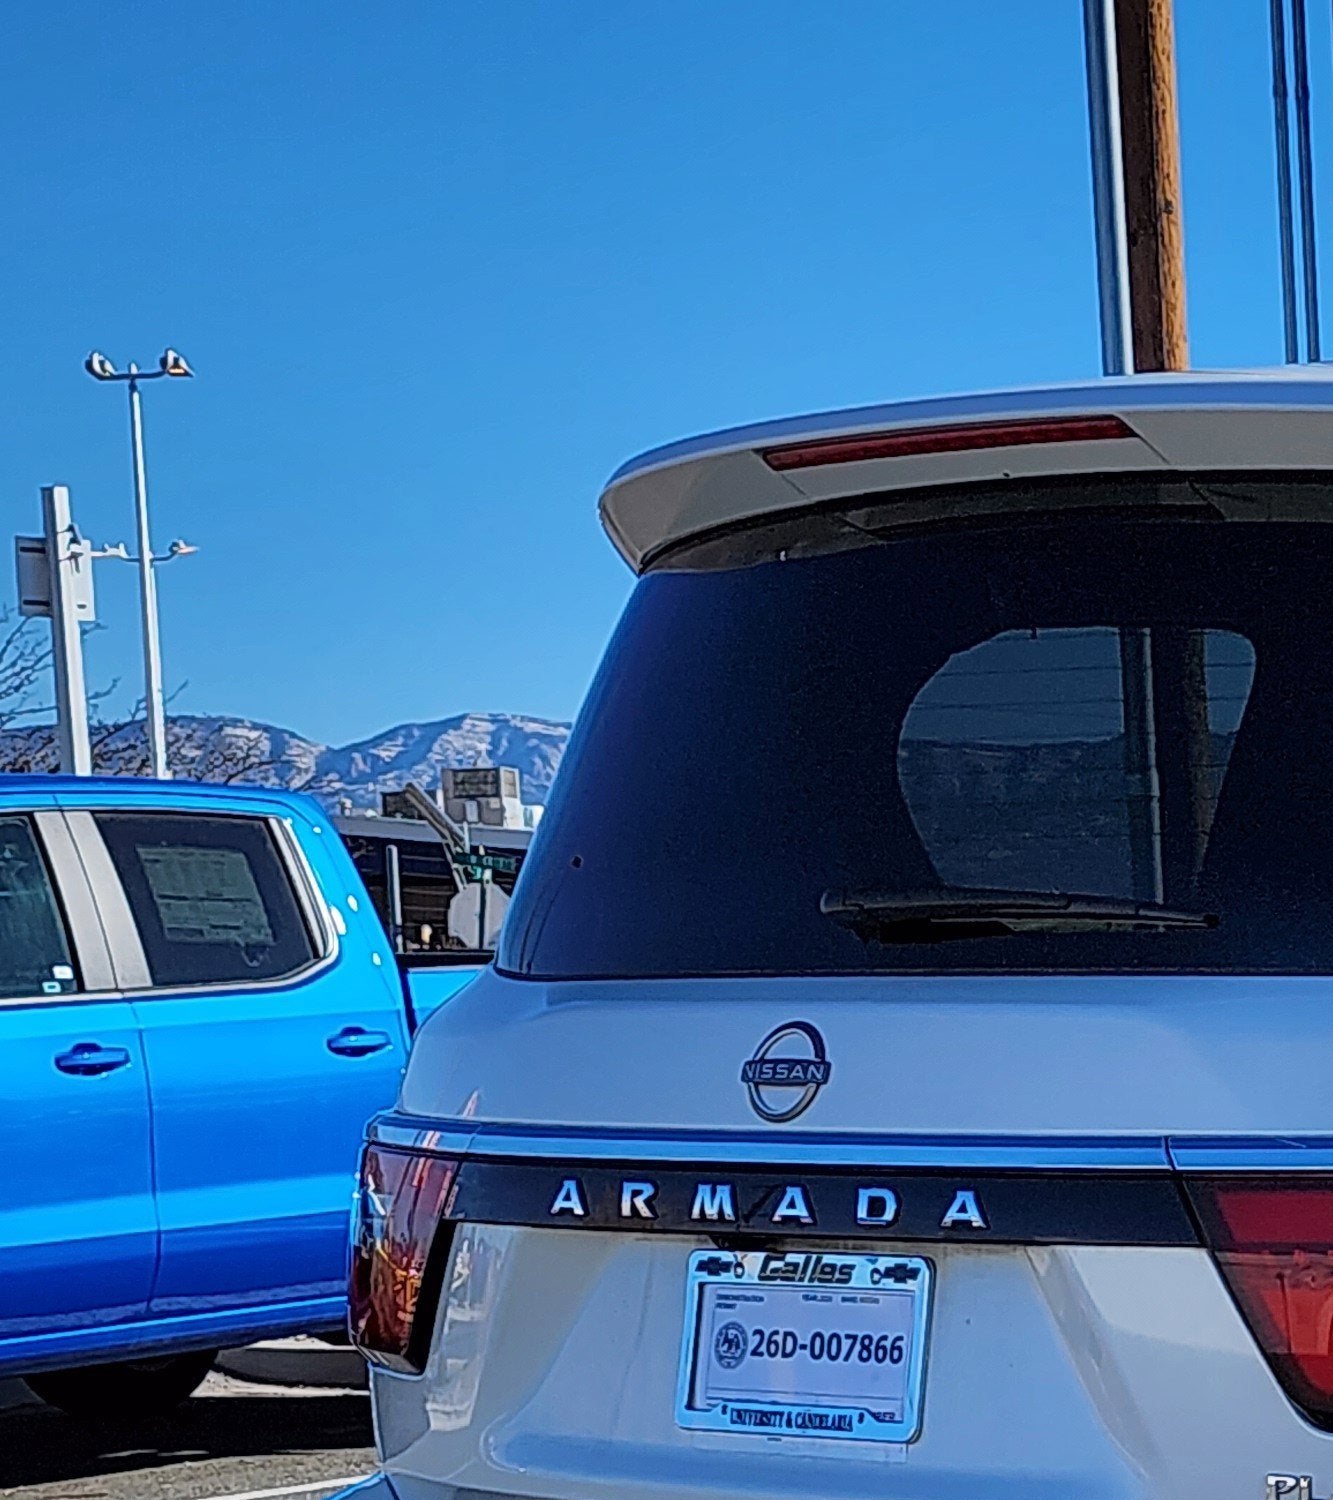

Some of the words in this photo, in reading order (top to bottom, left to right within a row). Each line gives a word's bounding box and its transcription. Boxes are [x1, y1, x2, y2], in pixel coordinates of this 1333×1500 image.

[744, 1062, 825, 1080] NISSAN
[550, 1178, 987, 1229] ARMADA
[750, 1328, 905, 1365] 26D-007866
